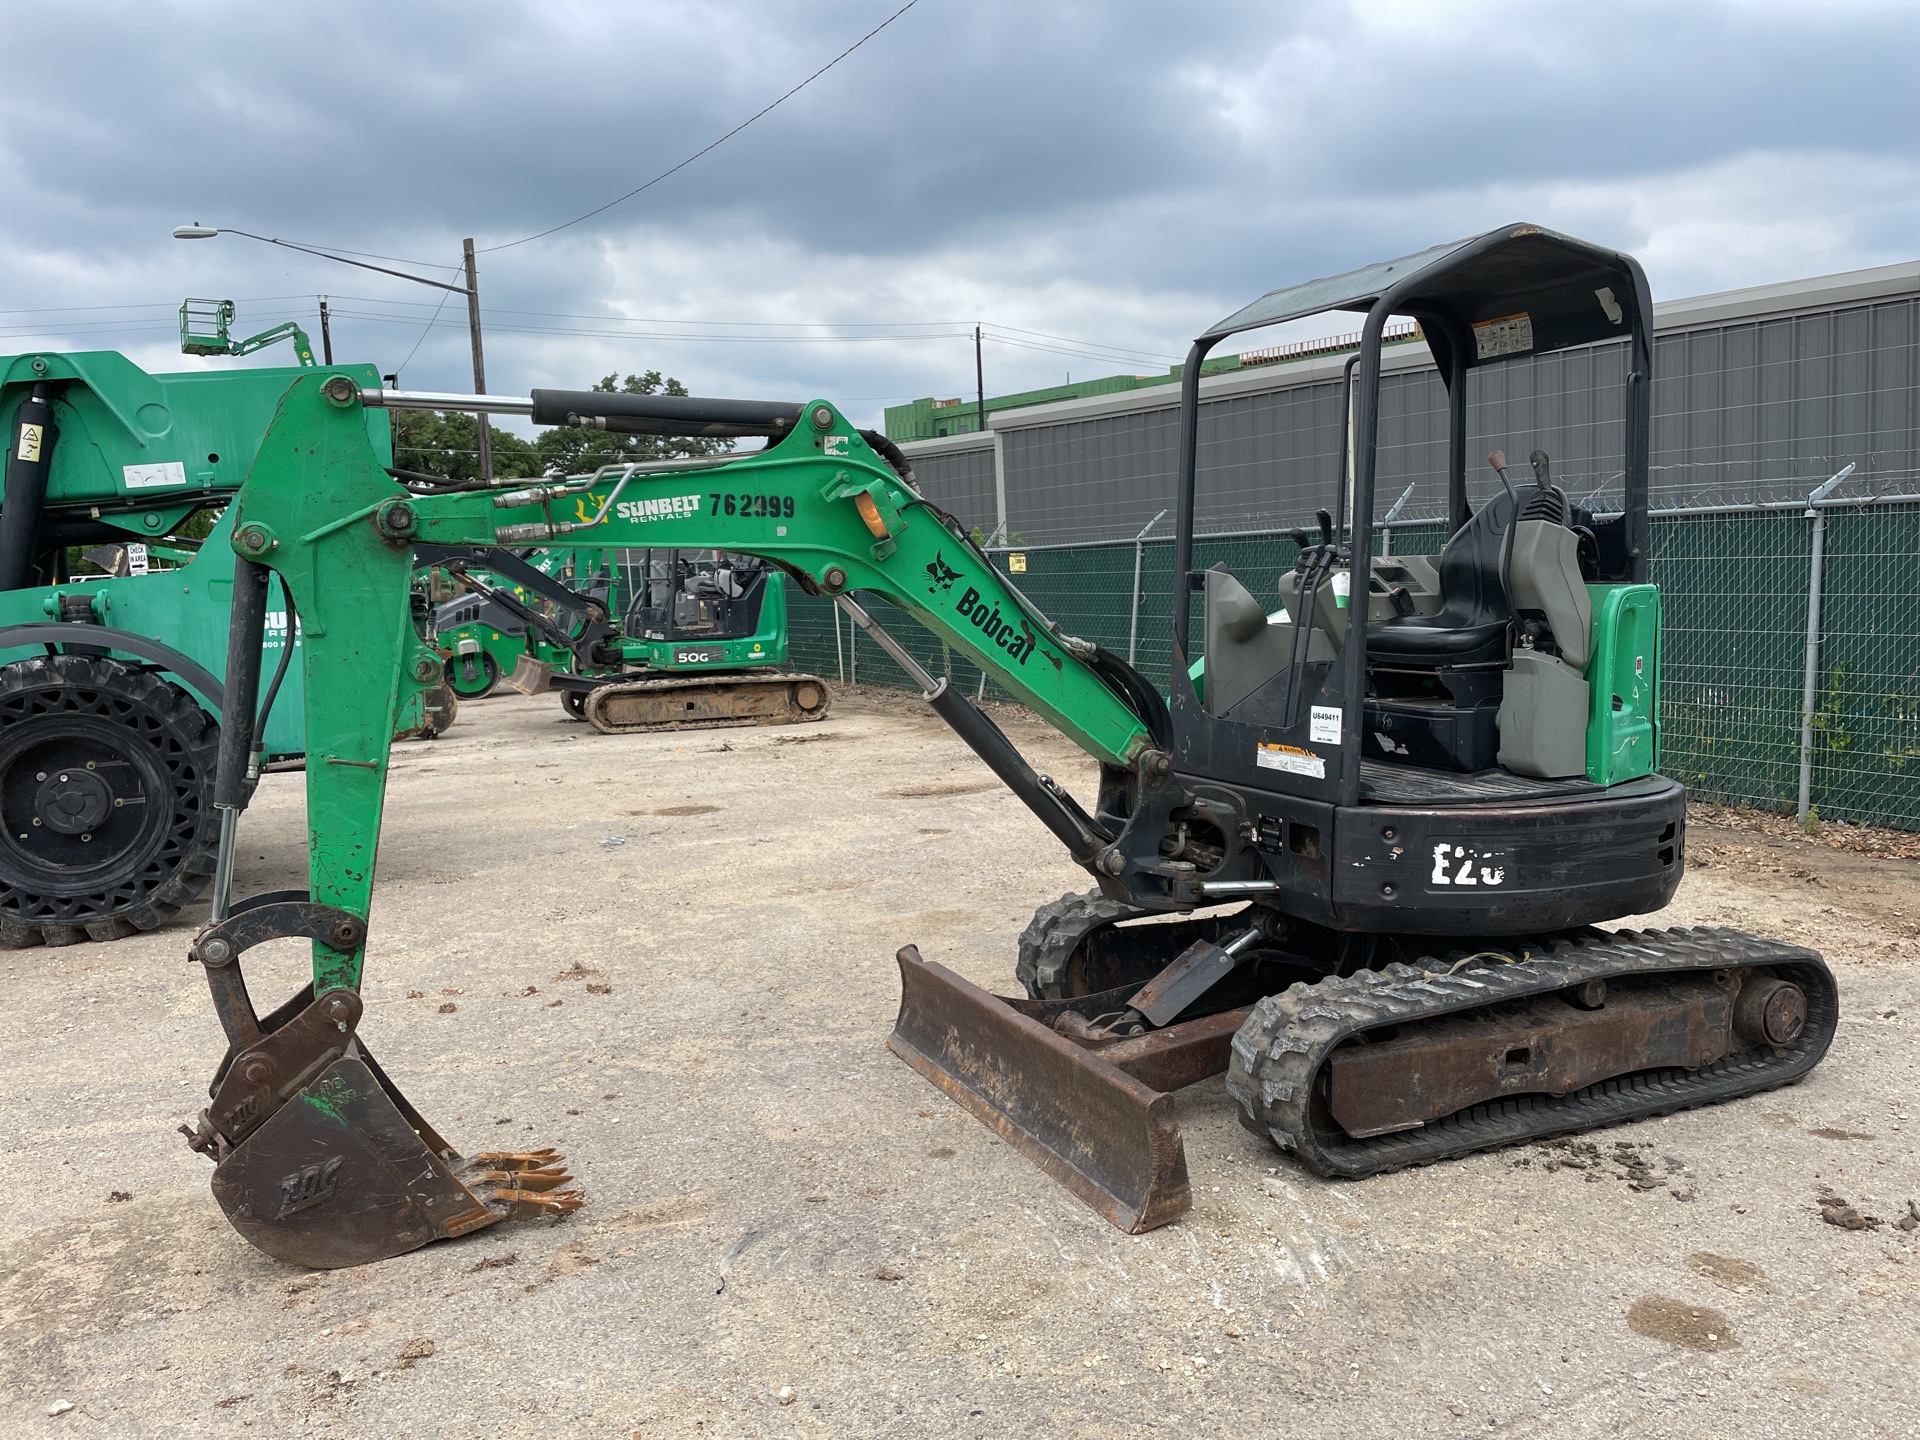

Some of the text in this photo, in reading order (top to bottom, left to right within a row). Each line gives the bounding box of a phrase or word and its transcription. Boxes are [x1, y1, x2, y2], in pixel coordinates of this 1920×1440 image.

[616, 494, 701, 519] SUNBELT
[630, 511, 692, 524] RENTALS
[130, 546, 144, 555] CHECK
[955, 586, 1036, 666] Bobcat
[678, 652, 709, 663] 50G
[1312, 712, 1339, 722] U649411
